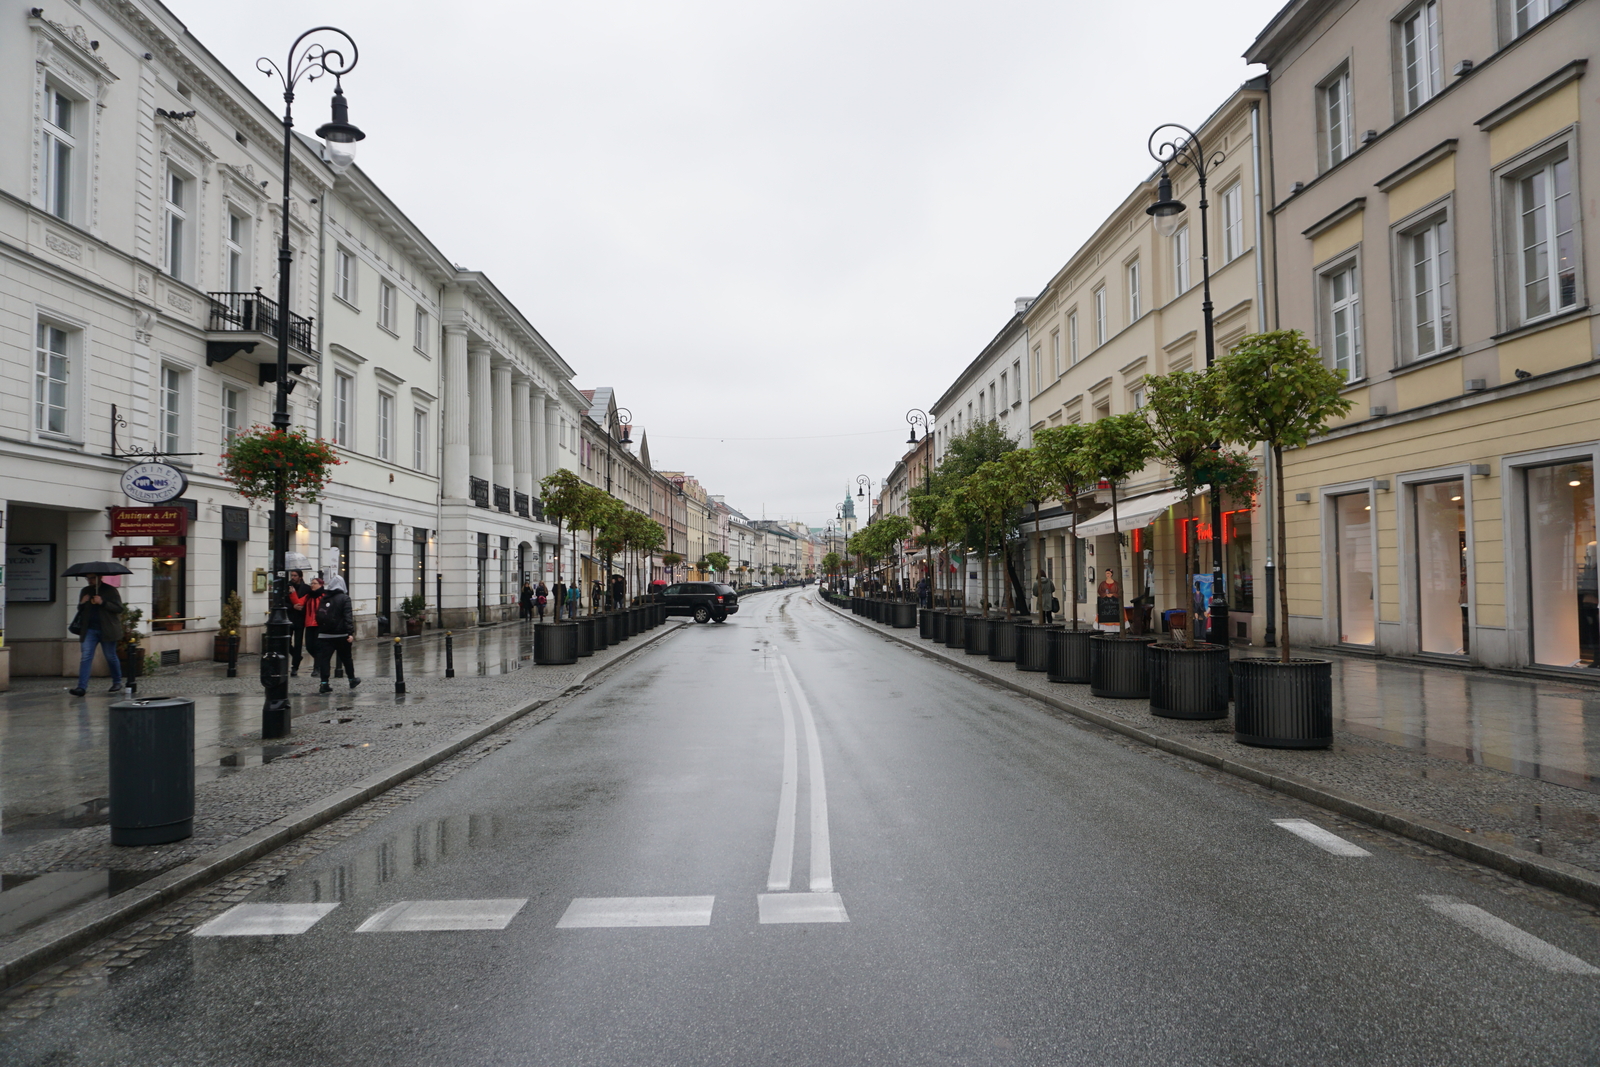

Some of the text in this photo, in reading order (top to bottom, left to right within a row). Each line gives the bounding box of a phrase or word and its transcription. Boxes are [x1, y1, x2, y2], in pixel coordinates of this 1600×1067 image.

[126, 466, 178, 481] GABINET
[126, 483, 177, 499] OKULISTYCZNY
[117, 511, 152, 521] Antique
[161, 511, 178, 519] Art
